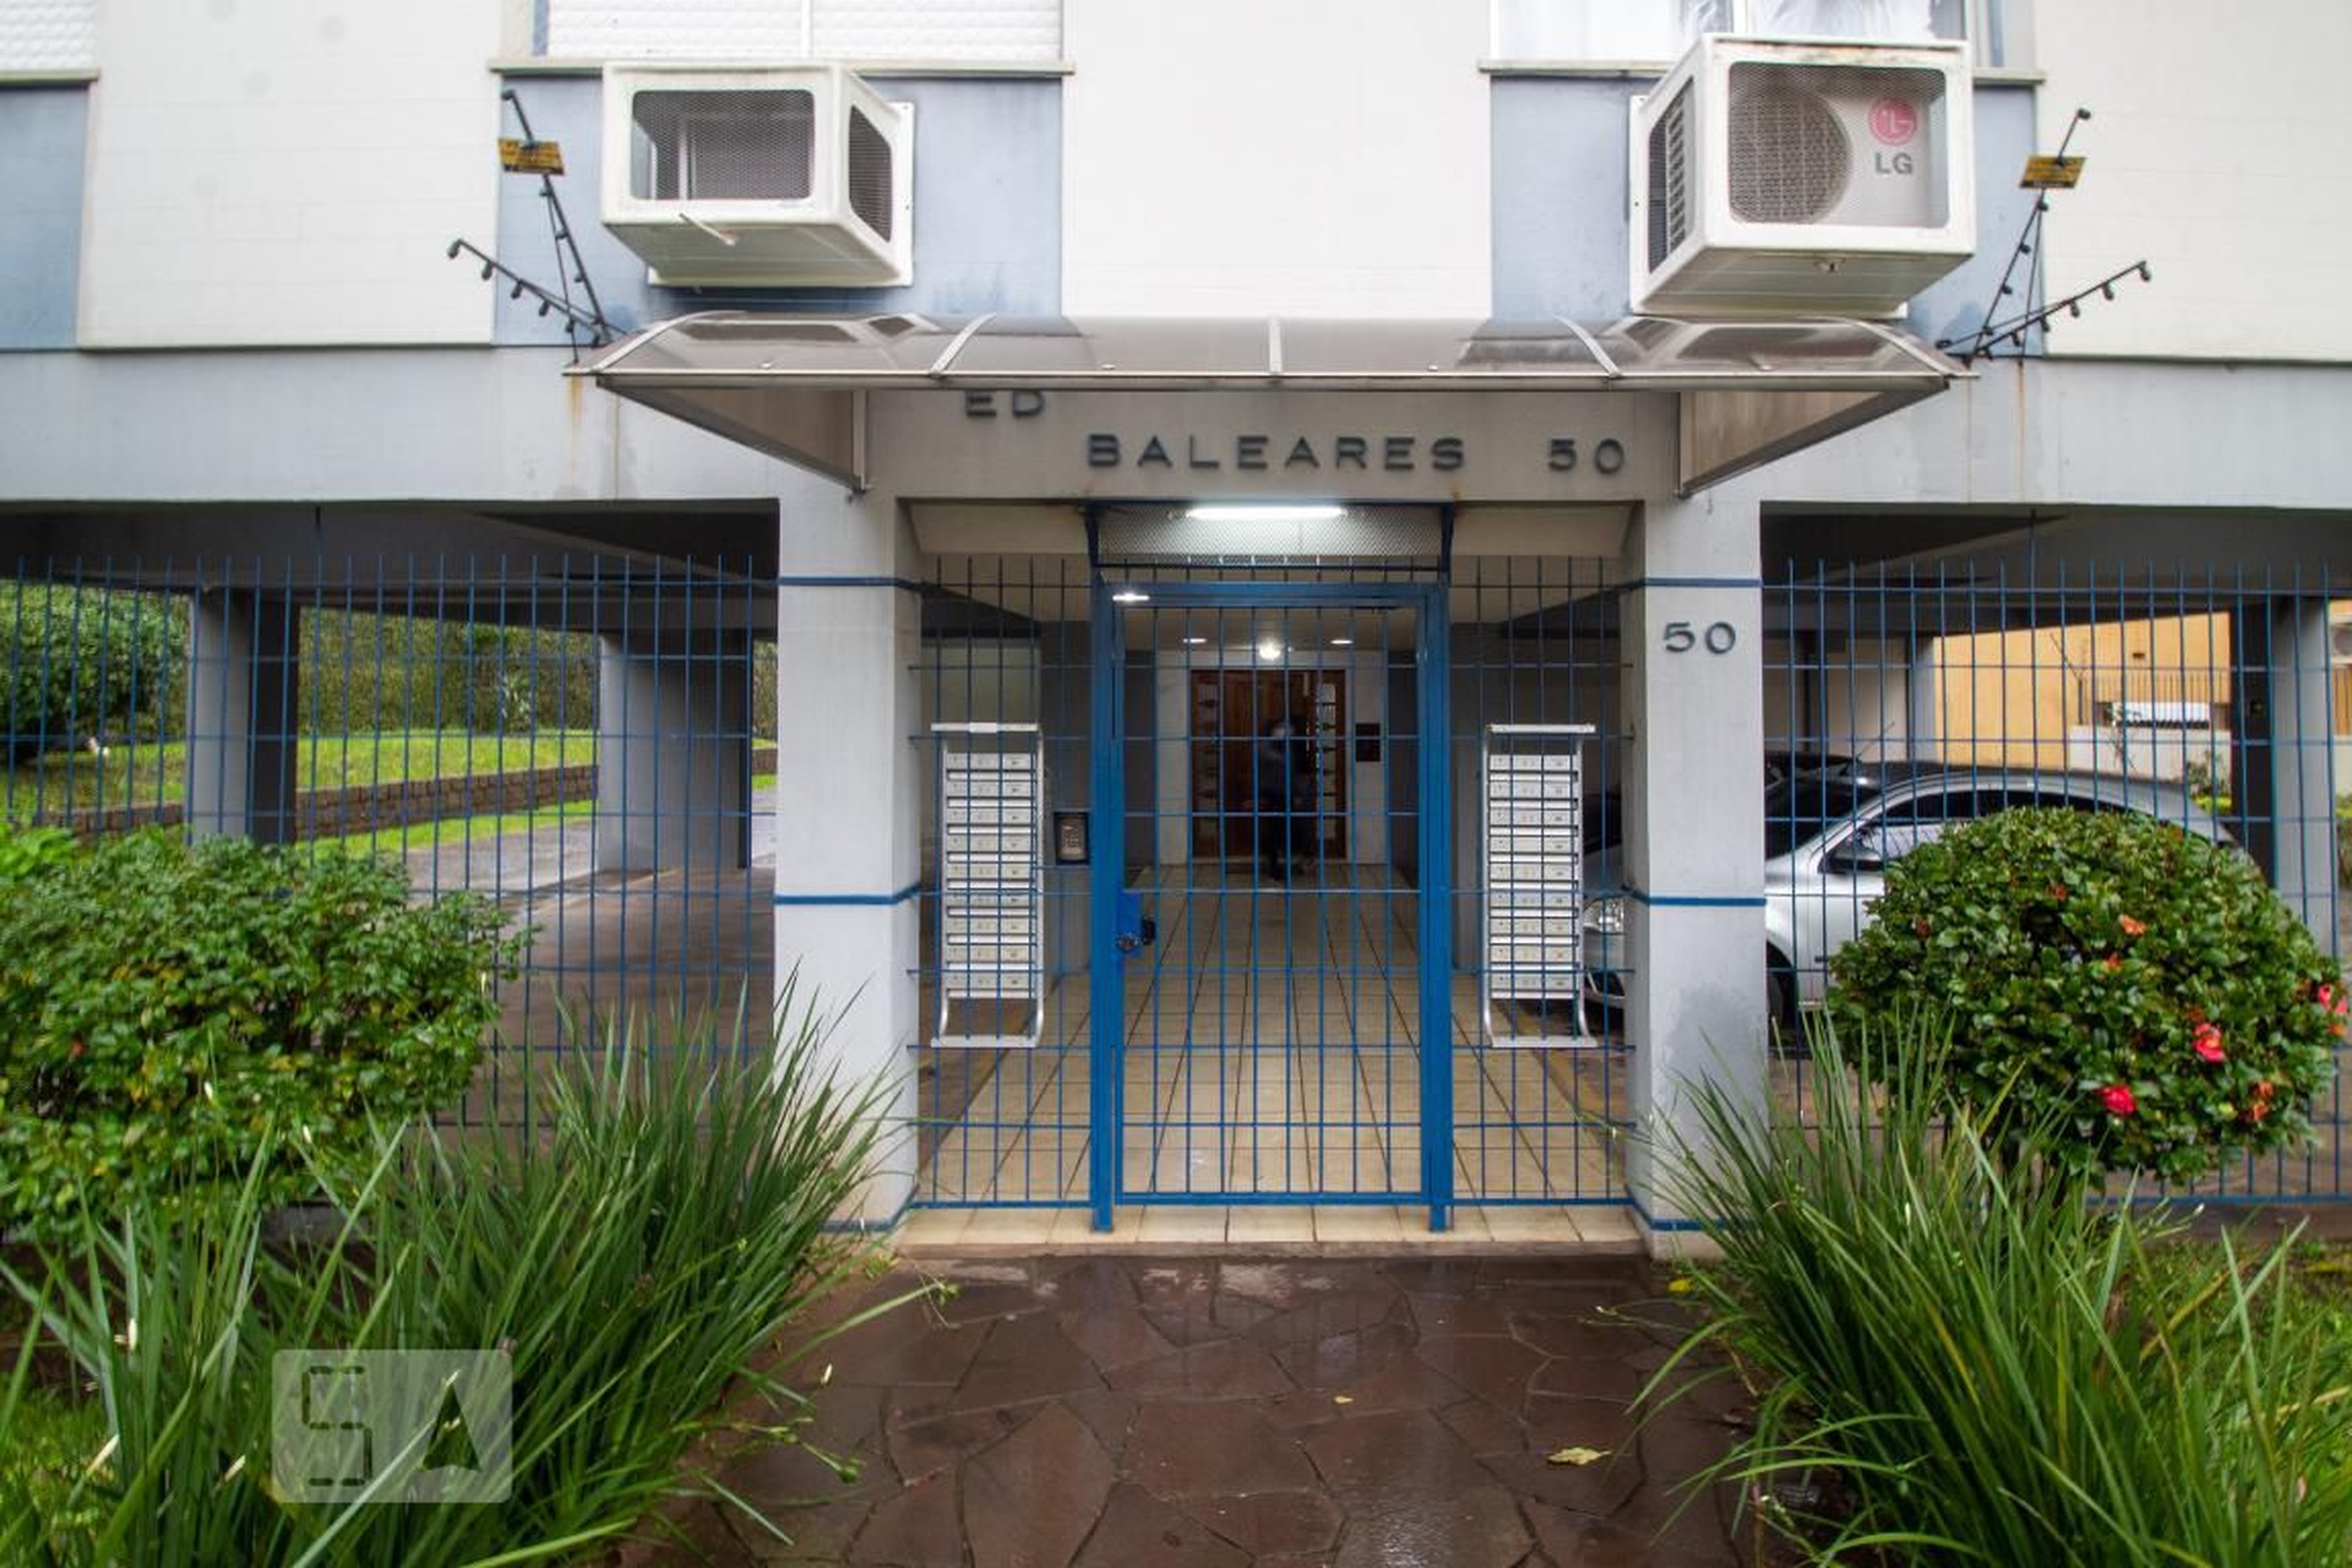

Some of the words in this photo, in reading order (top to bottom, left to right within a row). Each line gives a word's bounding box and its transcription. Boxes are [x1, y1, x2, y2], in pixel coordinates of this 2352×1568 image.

[1875, 152, 1913, 174] LG
[963, 390, 1046, 419] ED
[1087, 433, 1464, 472] BALEARES
[1547, 437, 1625, 475] 50
[1663, 621, 1736, 655] 50
